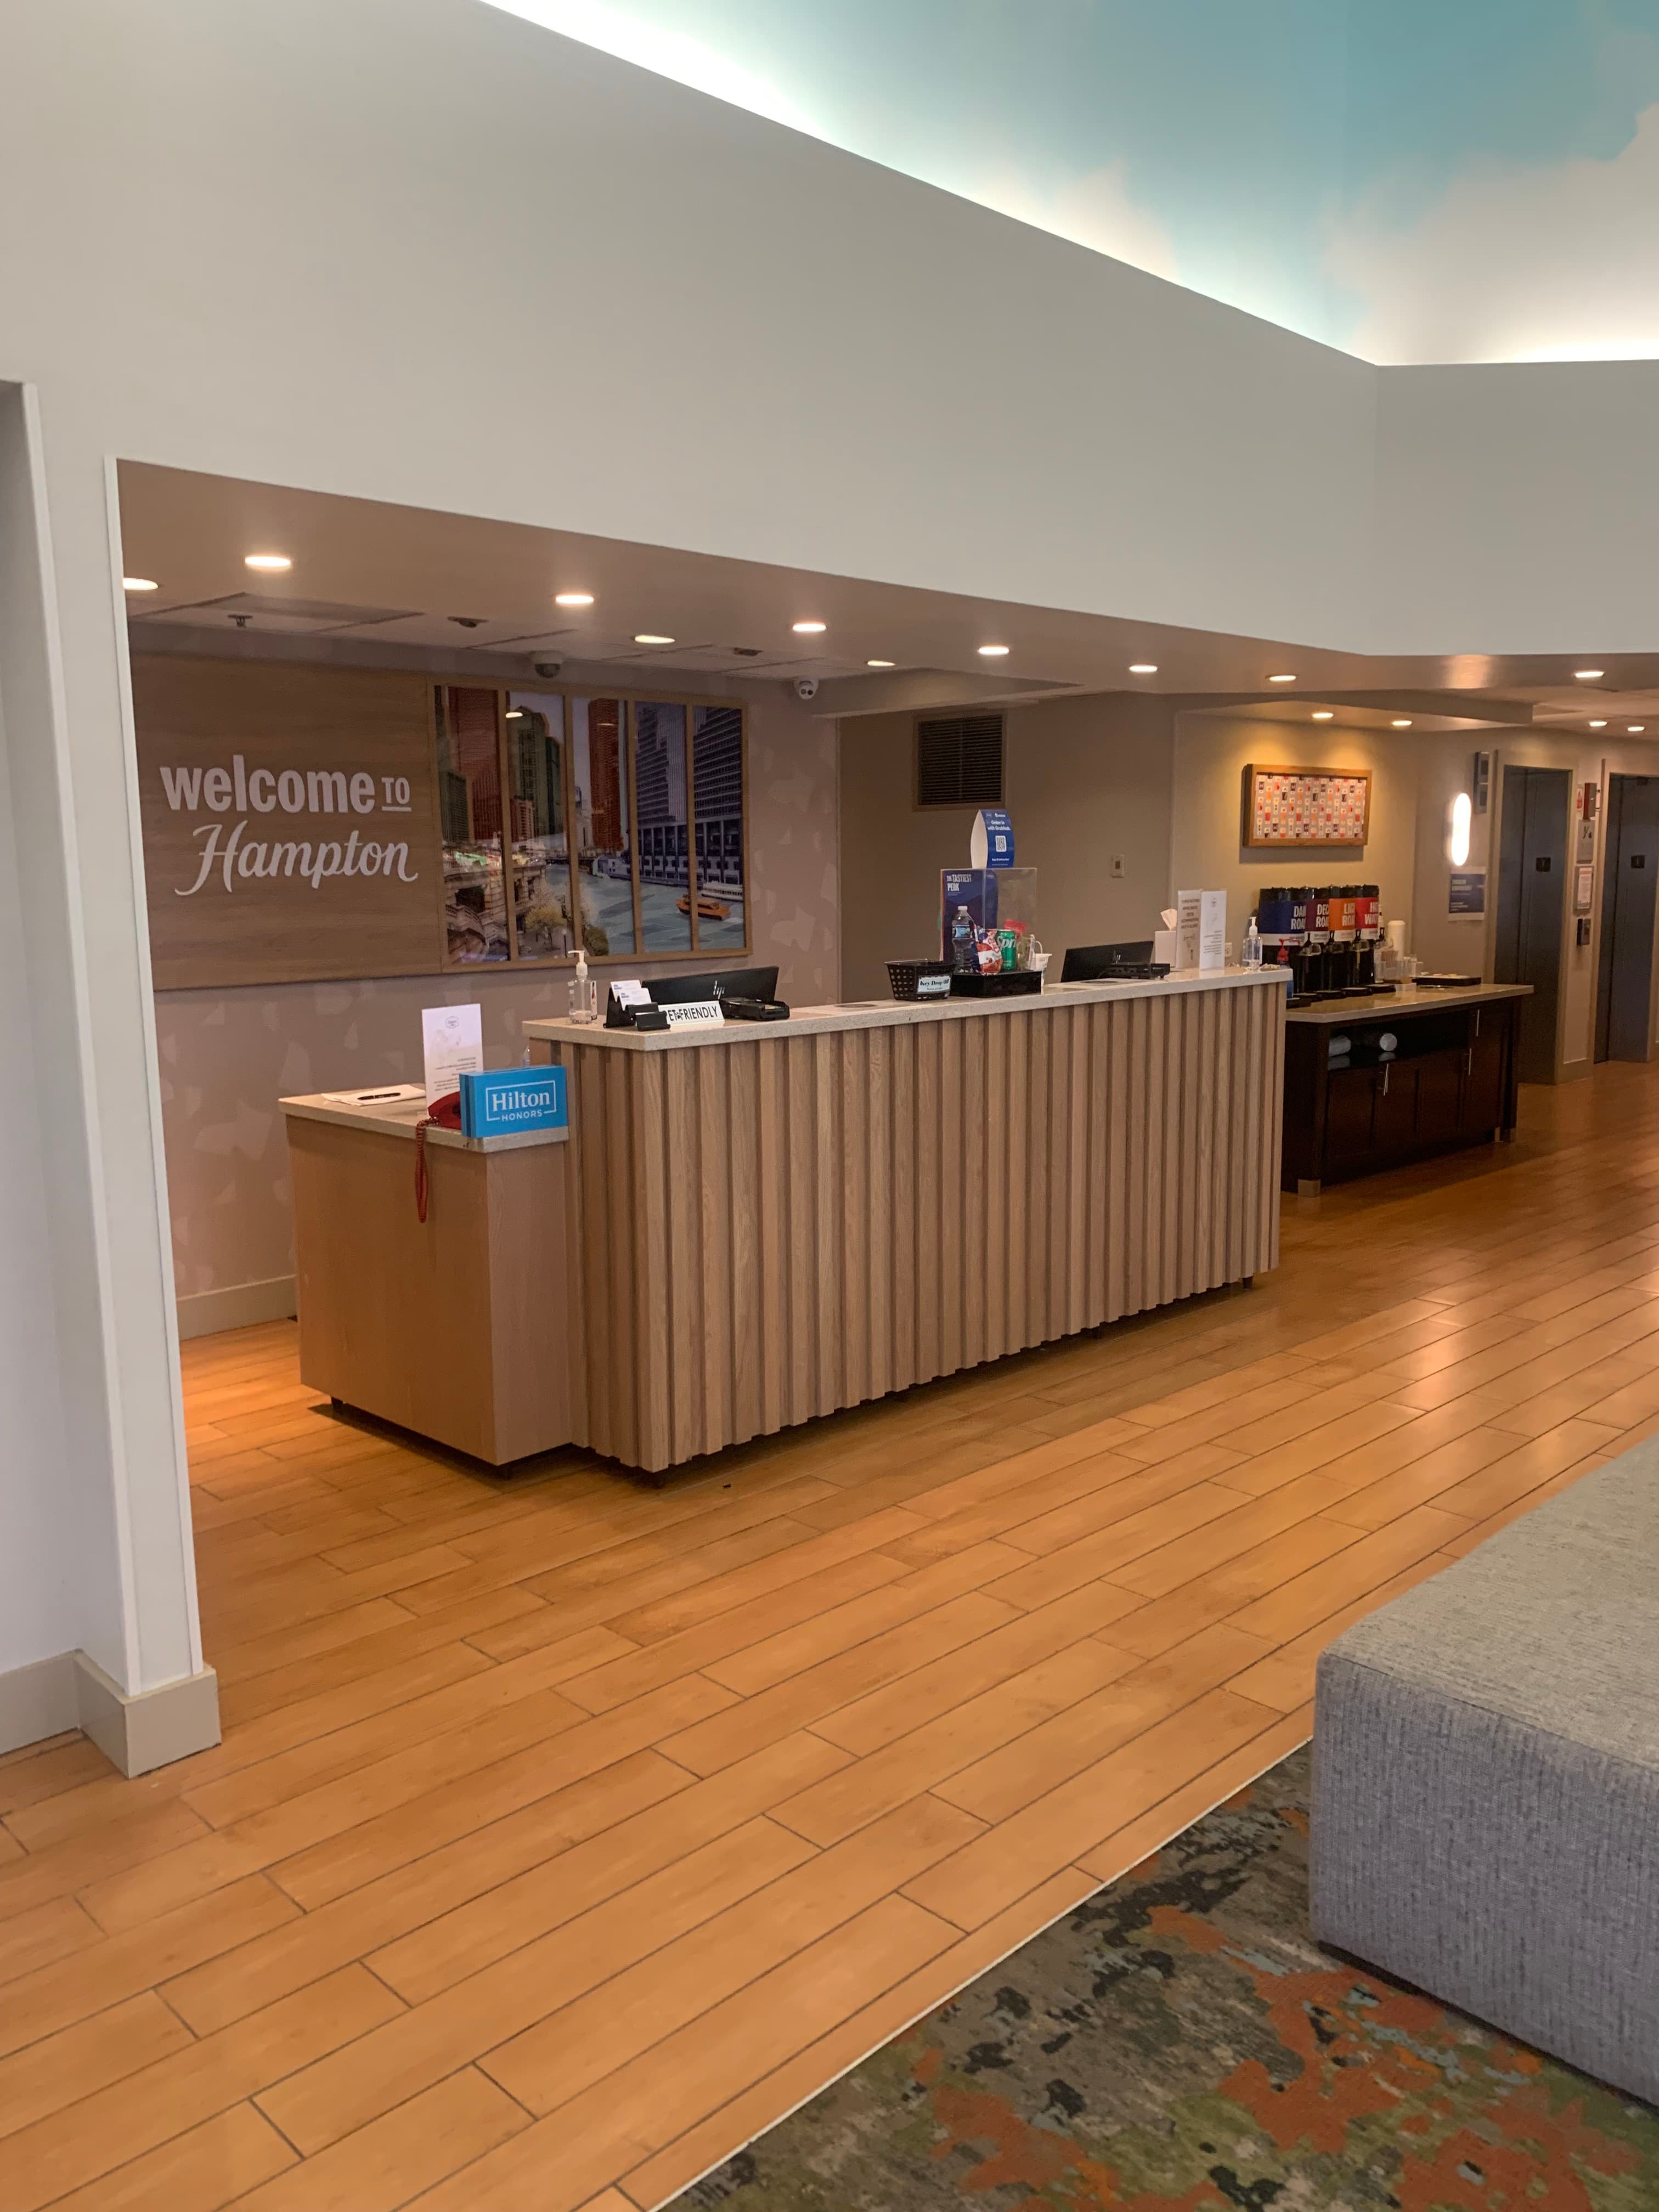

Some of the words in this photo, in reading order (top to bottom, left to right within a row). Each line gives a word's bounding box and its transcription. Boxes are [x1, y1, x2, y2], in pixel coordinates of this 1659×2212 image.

[160, 754, 375, 814] welcome
[381, 777, 411, 805] TO
[174, 820, 419, 896] Hampton
[952, 874, 972, 883] TASTIEST
[947, 883, 960, 891] PERK
[1317, 904, 1329, 916] DEC
[1290, 917, 1306, 930] ROA
[1315, 916, 1329, 928] ROA
[1342, 915, 1356, 926] ROA
[678, 1005, 718, 1020] FRIENDLY
[492, 1091, 551, 1112] Hilton
[501, 1109, 543, 1122] HONORS
